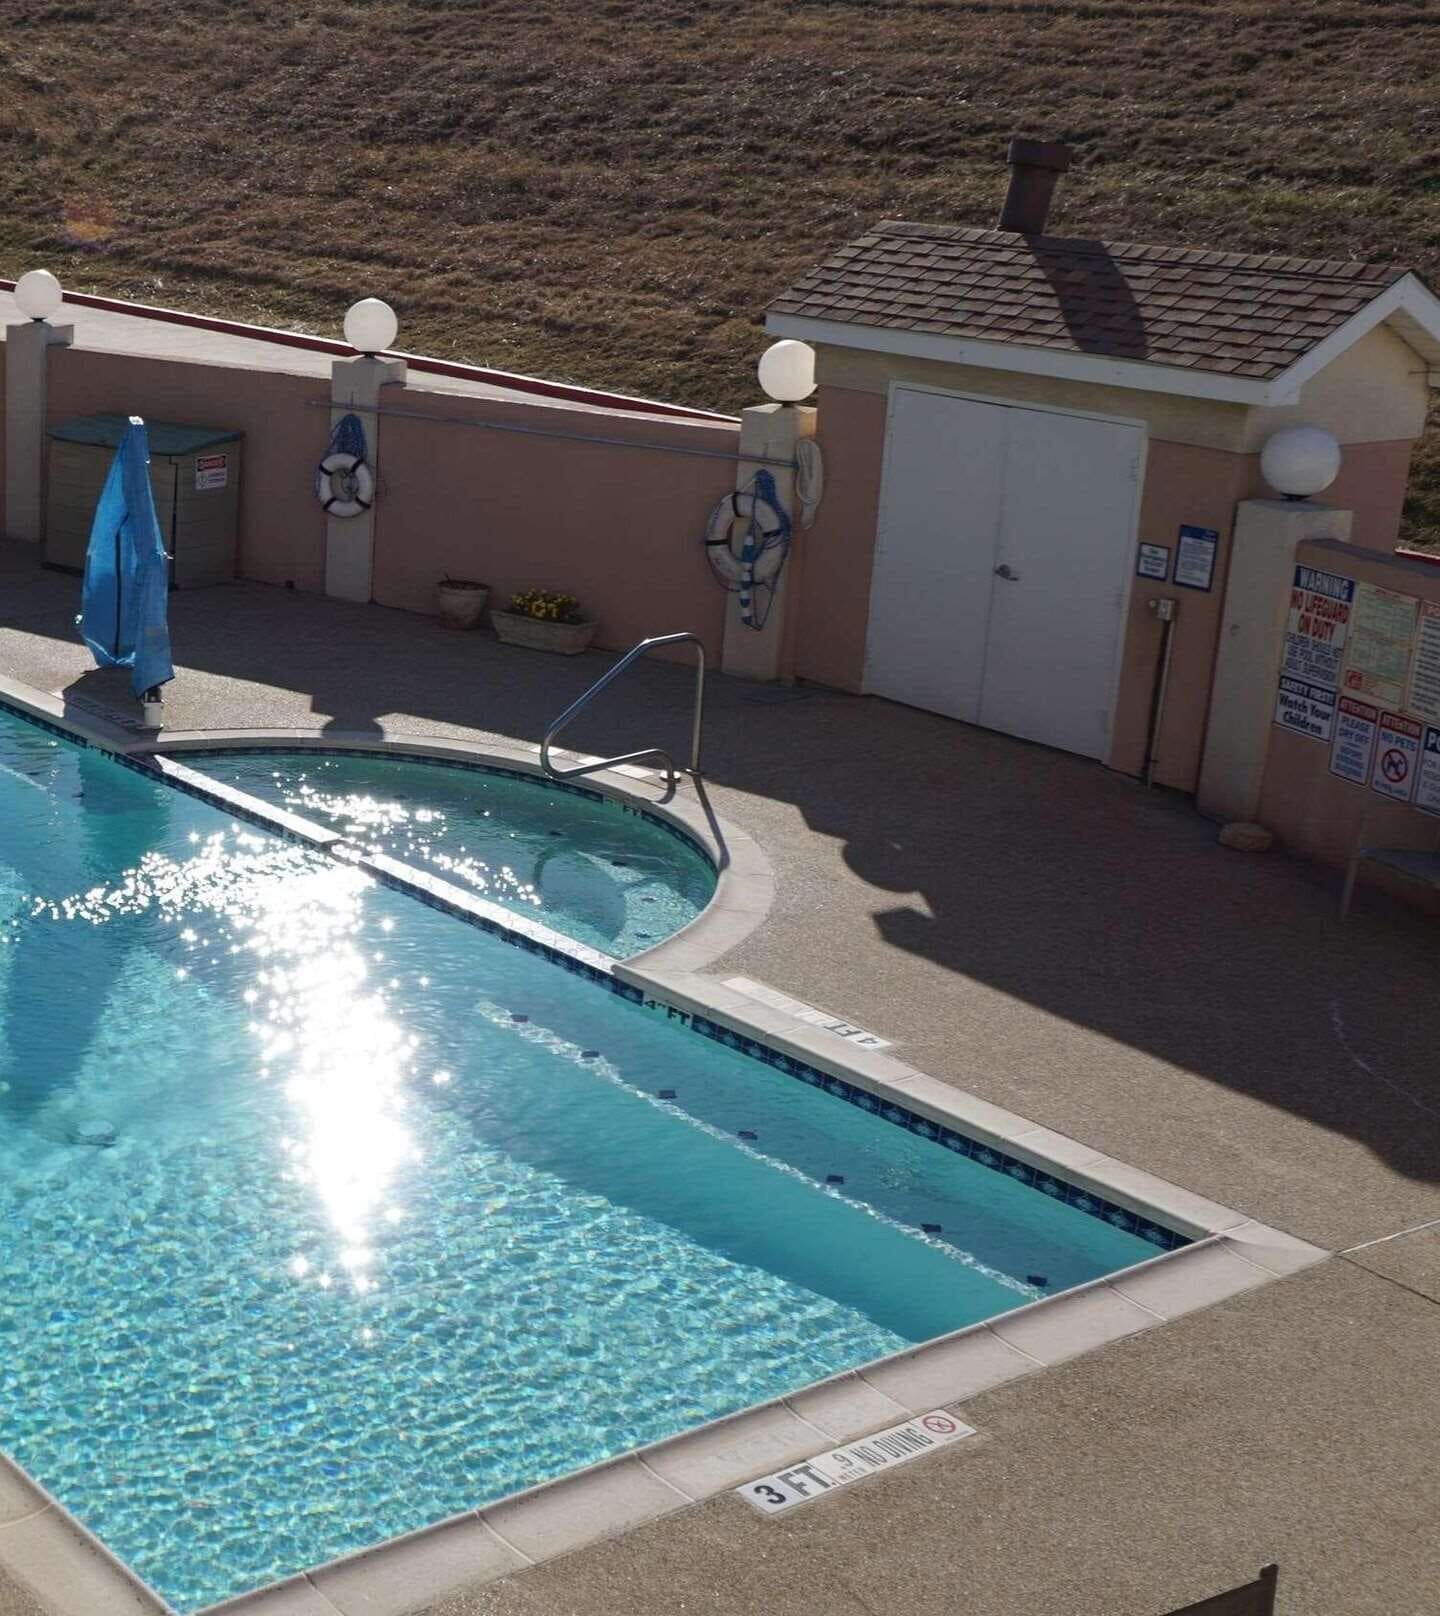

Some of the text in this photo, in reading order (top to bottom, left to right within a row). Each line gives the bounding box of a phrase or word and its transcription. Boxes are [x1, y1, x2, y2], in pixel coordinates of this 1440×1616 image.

[1300, 567, 1349, 600] WARNING
[1291, 591, 1303, 610] NO
[1305, 593, 1349, 624] LIFEGUARD
[1298, 614, 1336, 640] ON DUTY
[1280, 693, 1330, 721] Watch Your
[1283, 711, 1322, 734] Children
[1342, 716, 1370, 732] PLEASE
[1382, 731, 1417, 752] NO PETS
[824, 1023, 861, 1037] FT
[753, 1485, 786, 1505] 3
[849, 1446, 887, 1468] NO
[872, 1428, 934, 1460] DIVING
